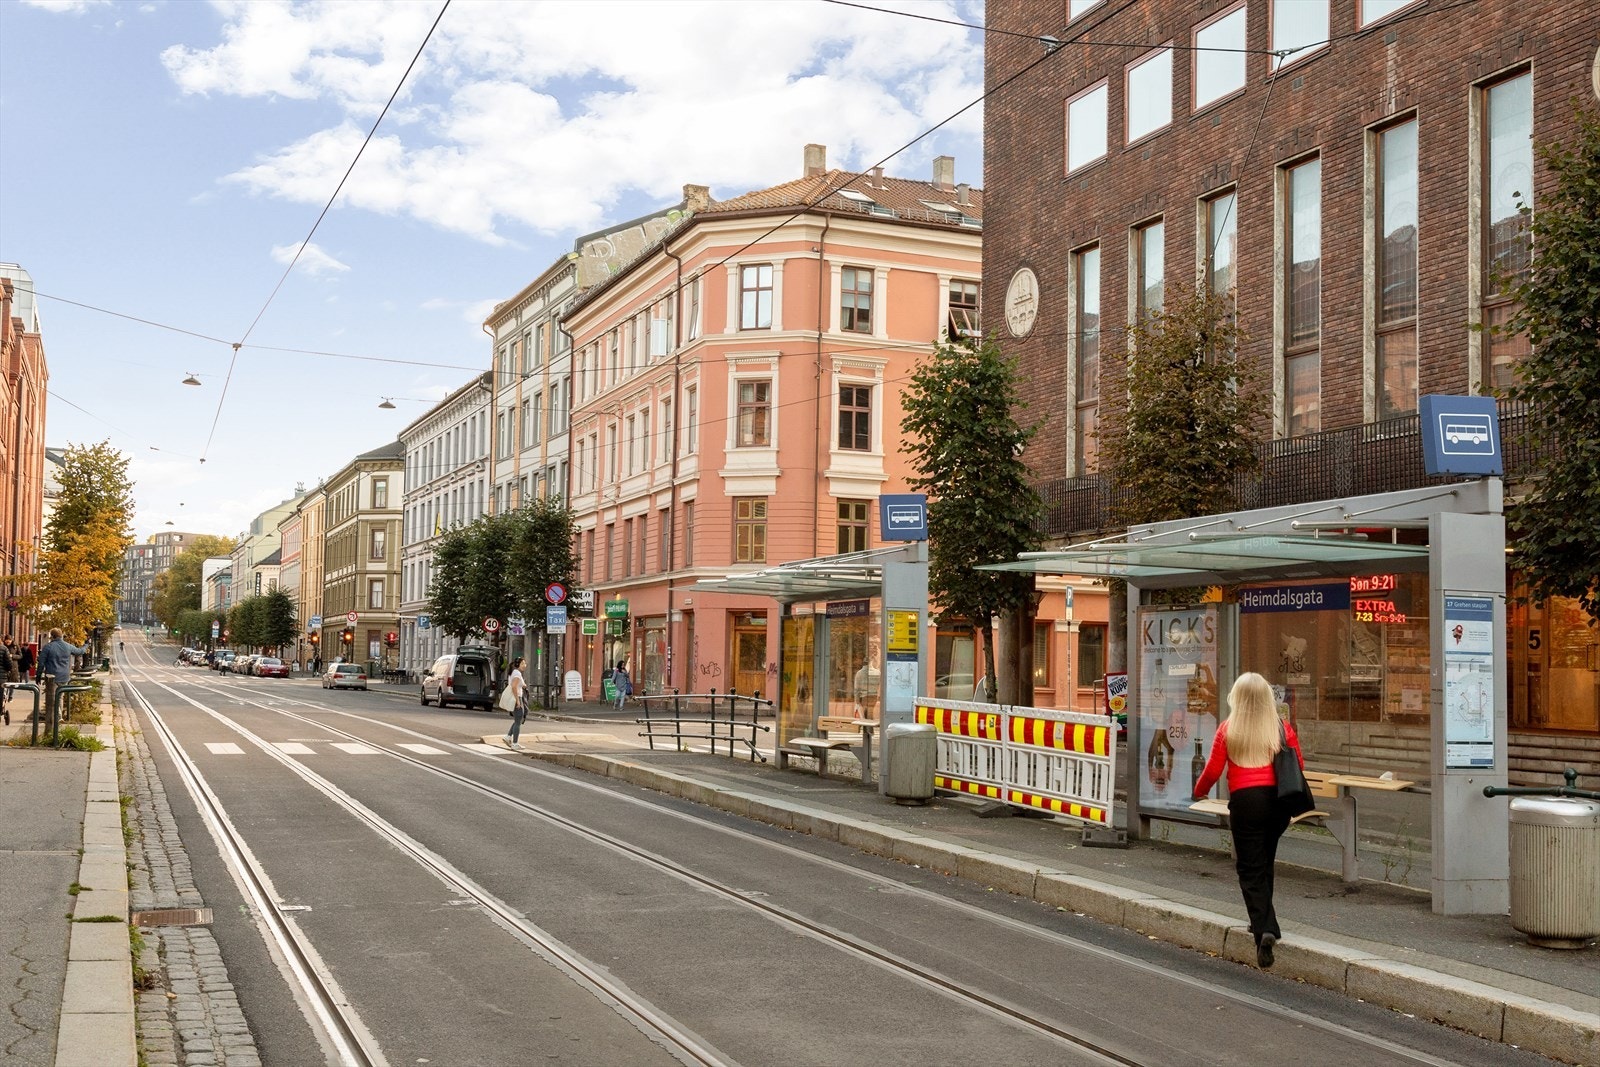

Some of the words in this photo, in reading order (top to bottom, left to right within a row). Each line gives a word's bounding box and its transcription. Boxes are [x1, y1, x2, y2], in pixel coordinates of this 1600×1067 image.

[1371, 575, 1394, 590] 9-21
[1243, 588, 1324, 609] Heimdalsgata
[1356, 599, 1396, 612] EXTRA
[548, 616, 565, 624] Taxi
[1355, 612, 1373, 622] 7-23
[486, 620, 498, 629] 40
[1143, 615, 1215, 646] KICKS
[1528, 629, 1541, 650] 5
[1153, 688, 1165, 698] CK
[1169, 726, 1187, 739] 25%
